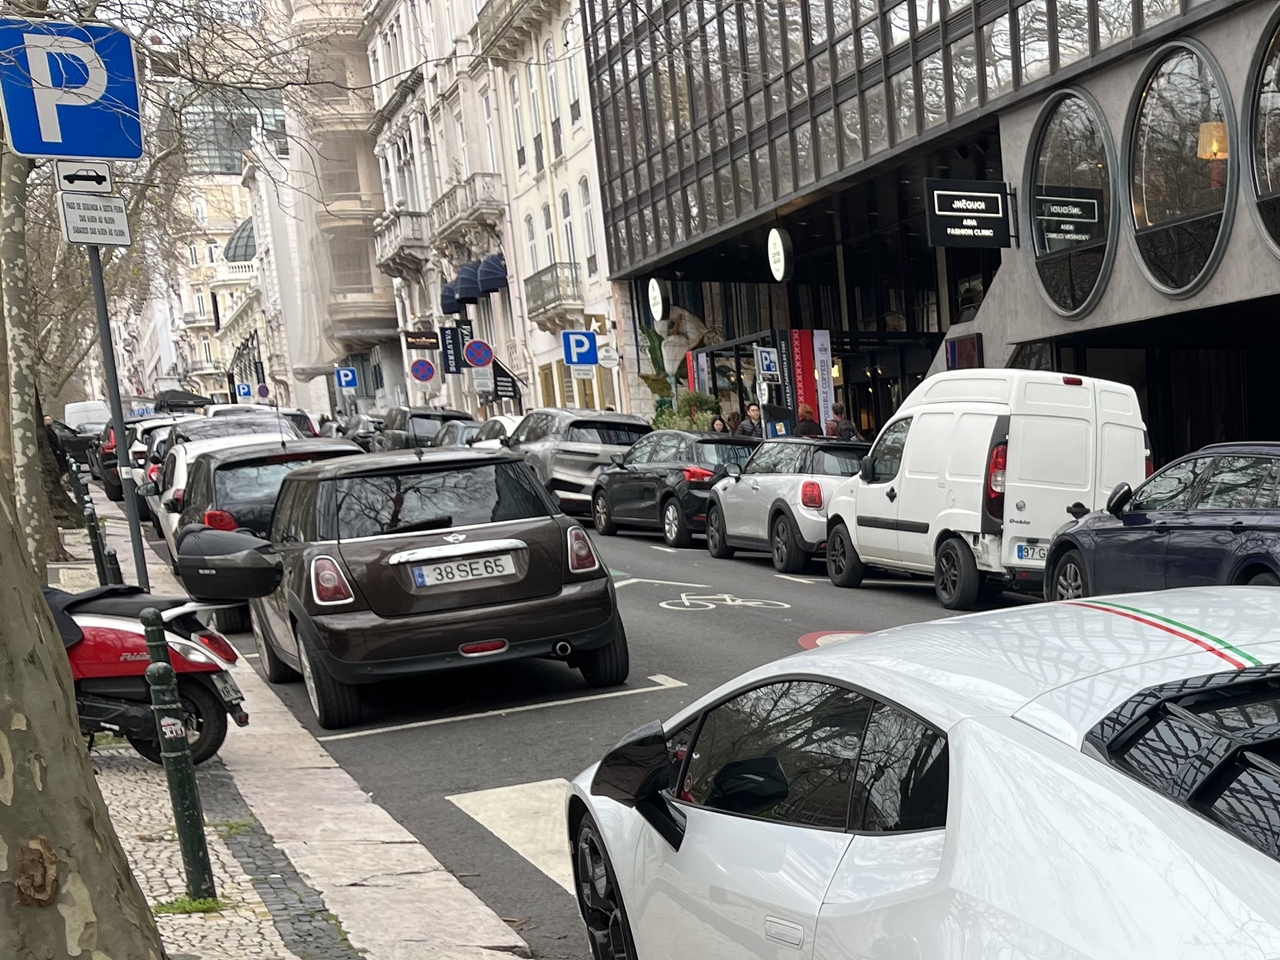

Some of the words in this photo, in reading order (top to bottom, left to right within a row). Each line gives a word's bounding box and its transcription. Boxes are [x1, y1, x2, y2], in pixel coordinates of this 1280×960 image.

[23, 33, 108, 143] P
[962, 218, 977, 226] ASIA
[946, 227, 973, 236] FASHION
[445, 329, 456, 373] VALVERDE
[569, 334, 590, 363] P
[340, 370, 353, 386] P
[240, 384, 248, 396] P
